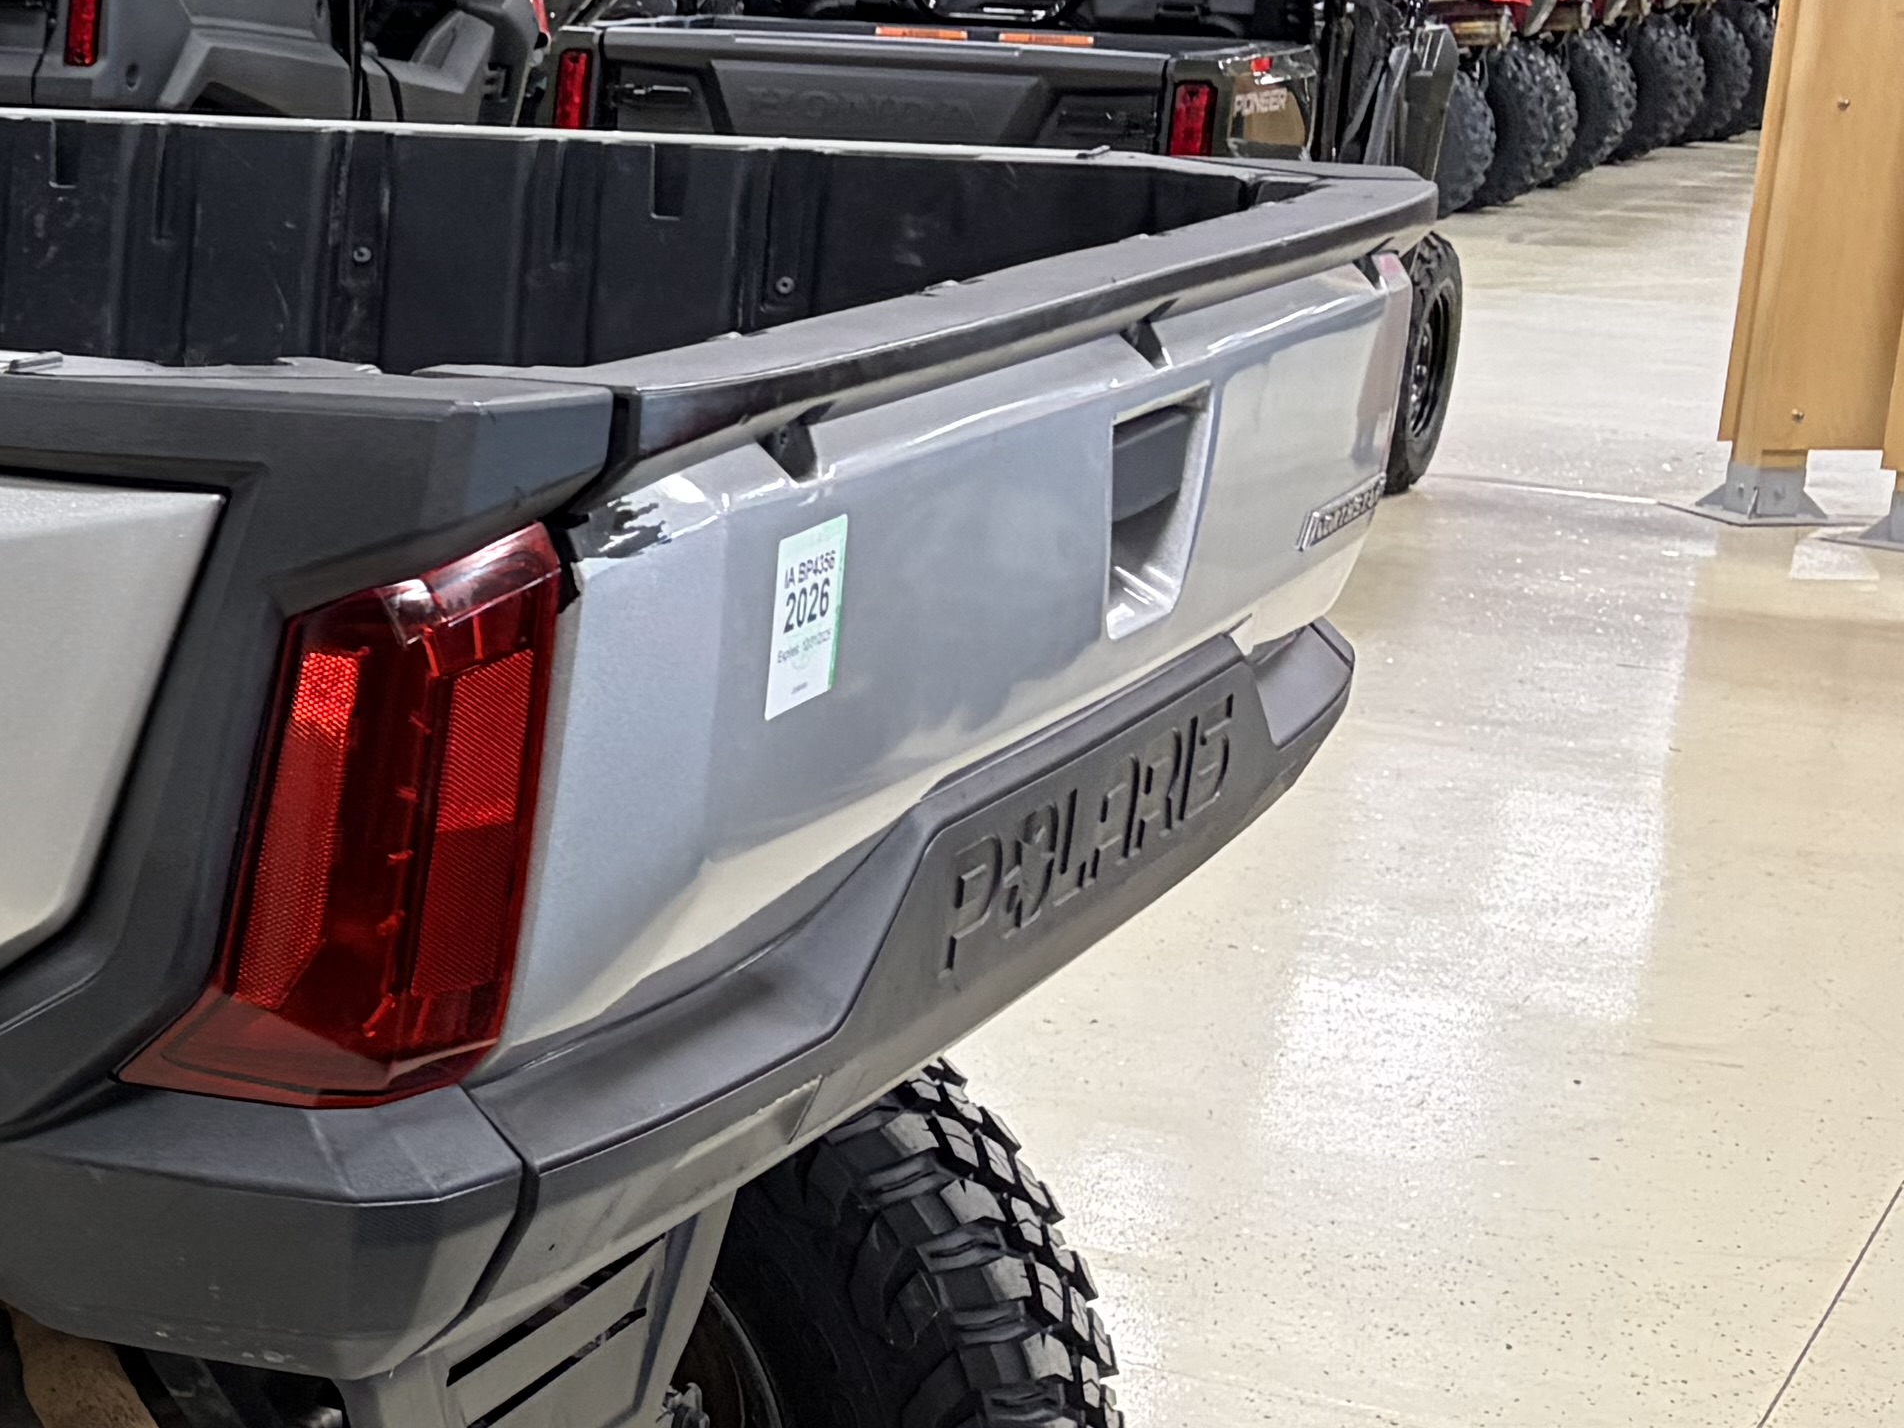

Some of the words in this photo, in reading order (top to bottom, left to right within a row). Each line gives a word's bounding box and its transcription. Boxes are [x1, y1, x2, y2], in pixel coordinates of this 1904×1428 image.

[1233, 87, 1288, 118] PIONEER
[783, 577, 831, 634] 2026
[937, 691, 1236, 979] POLARIS
